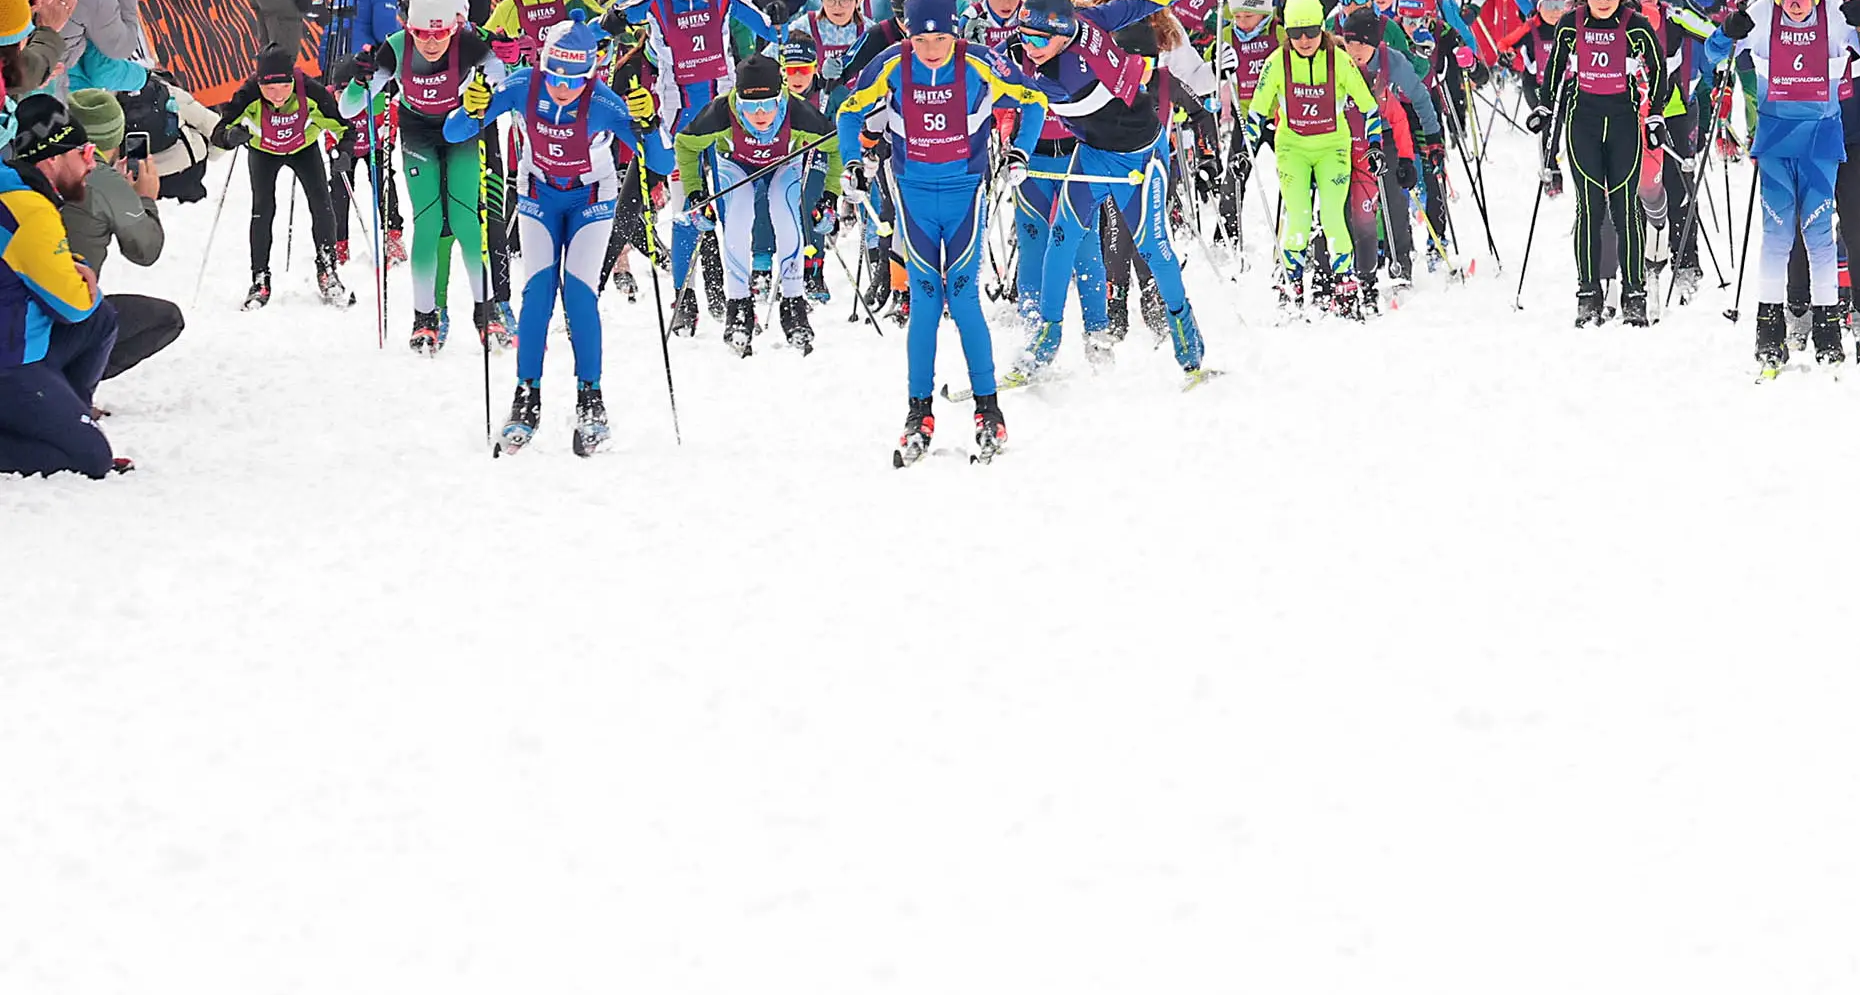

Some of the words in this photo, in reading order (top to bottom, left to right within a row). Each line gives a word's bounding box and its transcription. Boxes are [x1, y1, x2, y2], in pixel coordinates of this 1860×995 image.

[689, 13, 710, 24] ITAS
[1595, 33, 1615, 41] ITAS
[1792, 30, 1816, 42] ITAS
[692, 35, 705, 52] 21
[1591, 52, 1609, 67] 70
[1793, 54, 1803, 71] 6
[429, 74, 447, 84] ITAS
[423, 89, 437, 99] 12
[927, 89, 952, 100] ITAS
[1305, 88, 1325, 96] ITAS
[1302, 104, 1318, 116] 76
[284, 114, 299, 125] ITAS
[923, 113, 946, 131] 58
[277, 128, 292, 139] 55
[551, 128, 575, 137] ITAS
[548, 143, 564, 157] 15
[753, 149, 771, 158] 26
